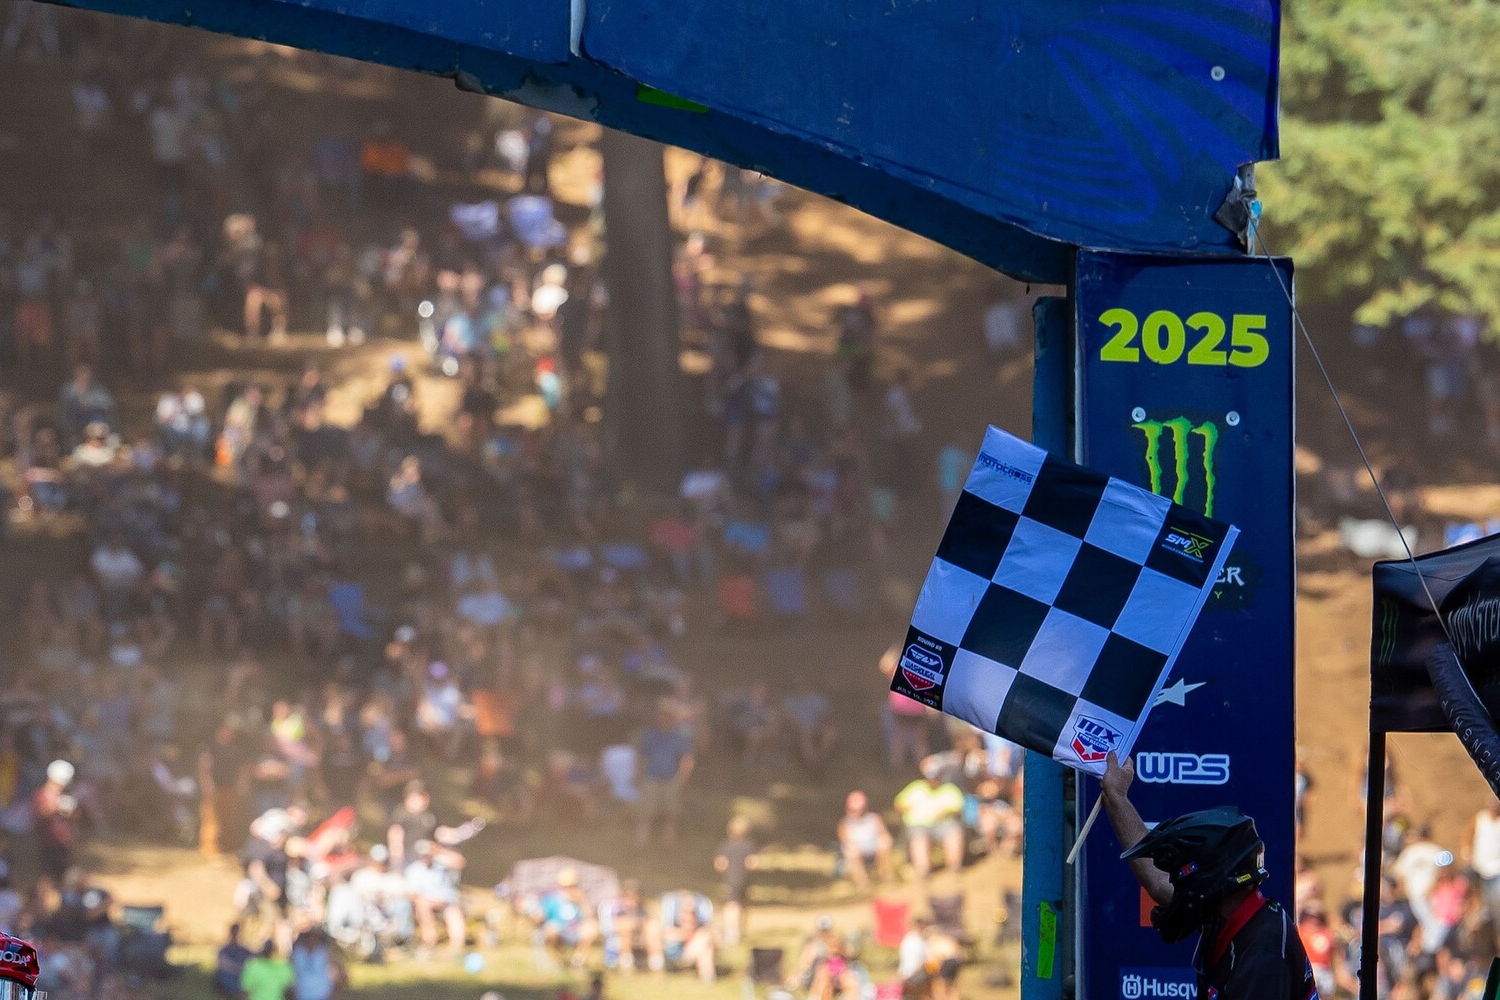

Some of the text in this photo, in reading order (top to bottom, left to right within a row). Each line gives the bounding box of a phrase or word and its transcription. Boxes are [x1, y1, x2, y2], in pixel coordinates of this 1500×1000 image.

[1099, 309, 1271, 368] 2025
[1165, 533, 1210, 559] SMX
[1137, 752, 1230, 785] WPS
[1143, 978, 1198, 1000] Husqv
